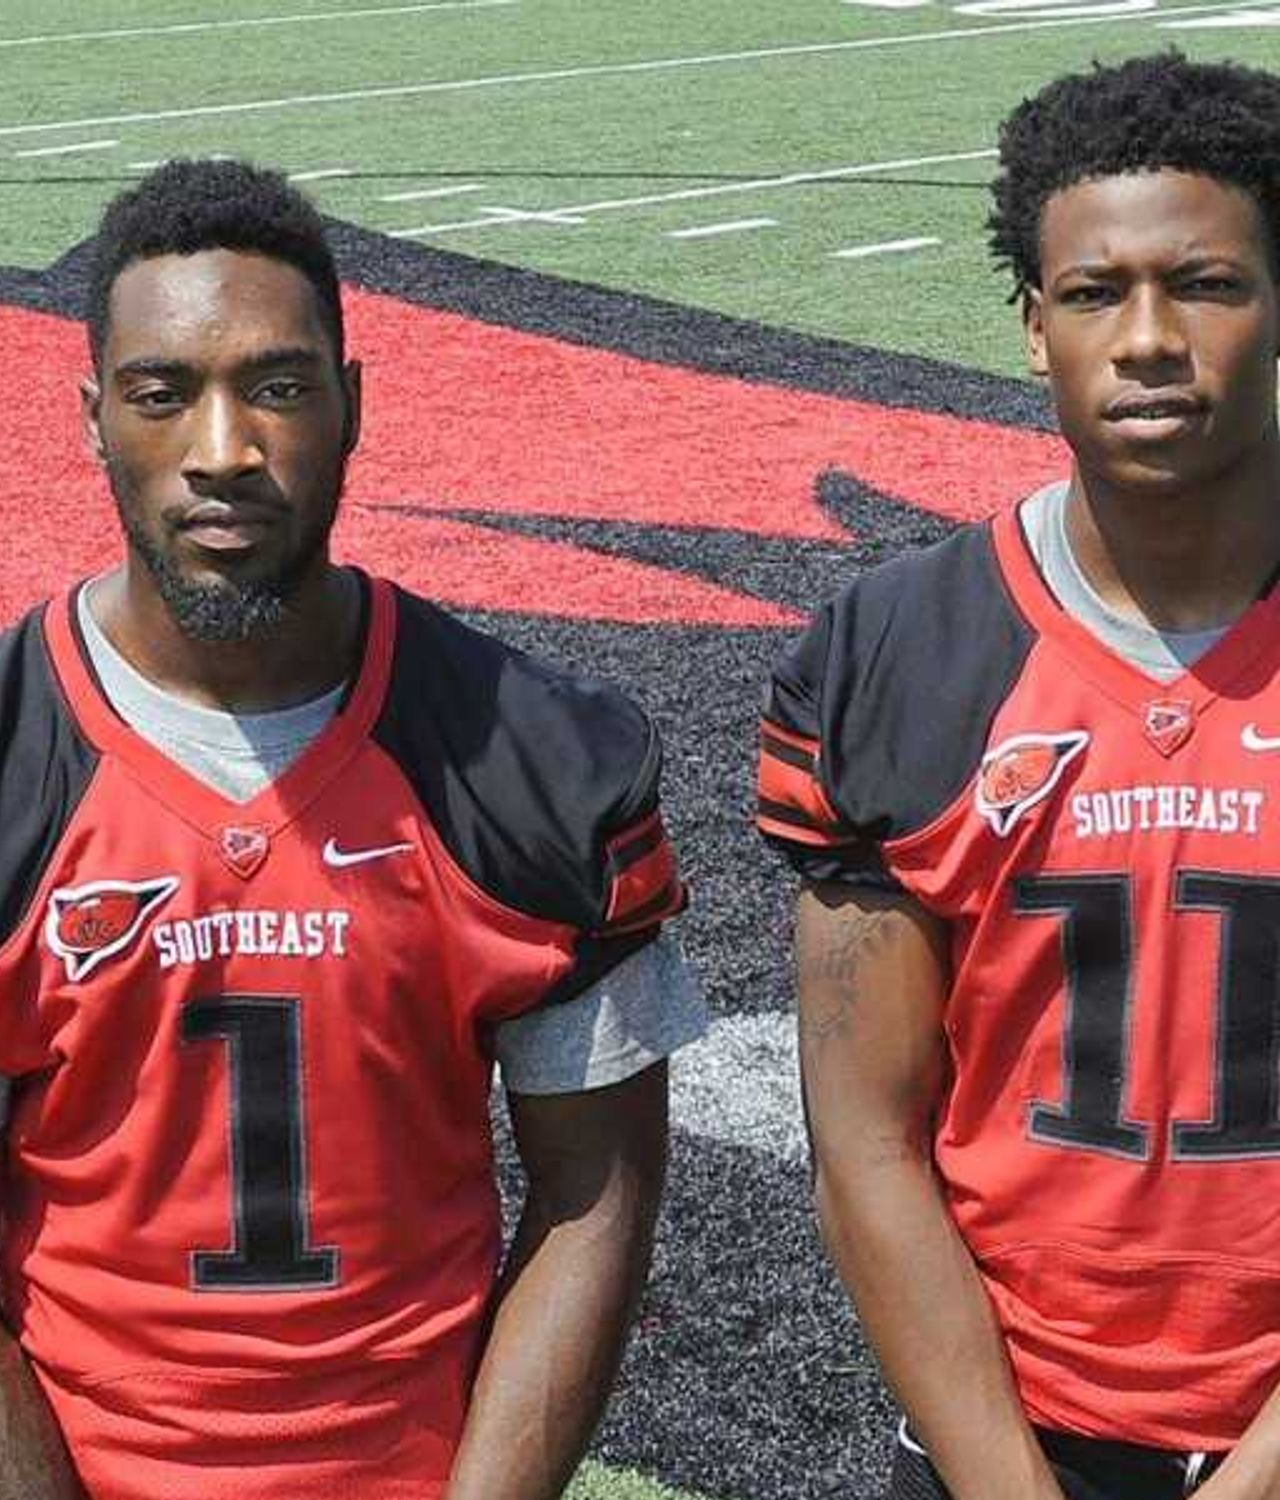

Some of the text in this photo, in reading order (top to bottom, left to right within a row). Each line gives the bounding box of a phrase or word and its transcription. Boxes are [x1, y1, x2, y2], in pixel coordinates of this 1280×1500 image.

[1073, 789, 1262, 837] SOUTHEAST
[153, 911, 348, 968] SOUTHEAST
[181, 992, 341, 1291] 1
